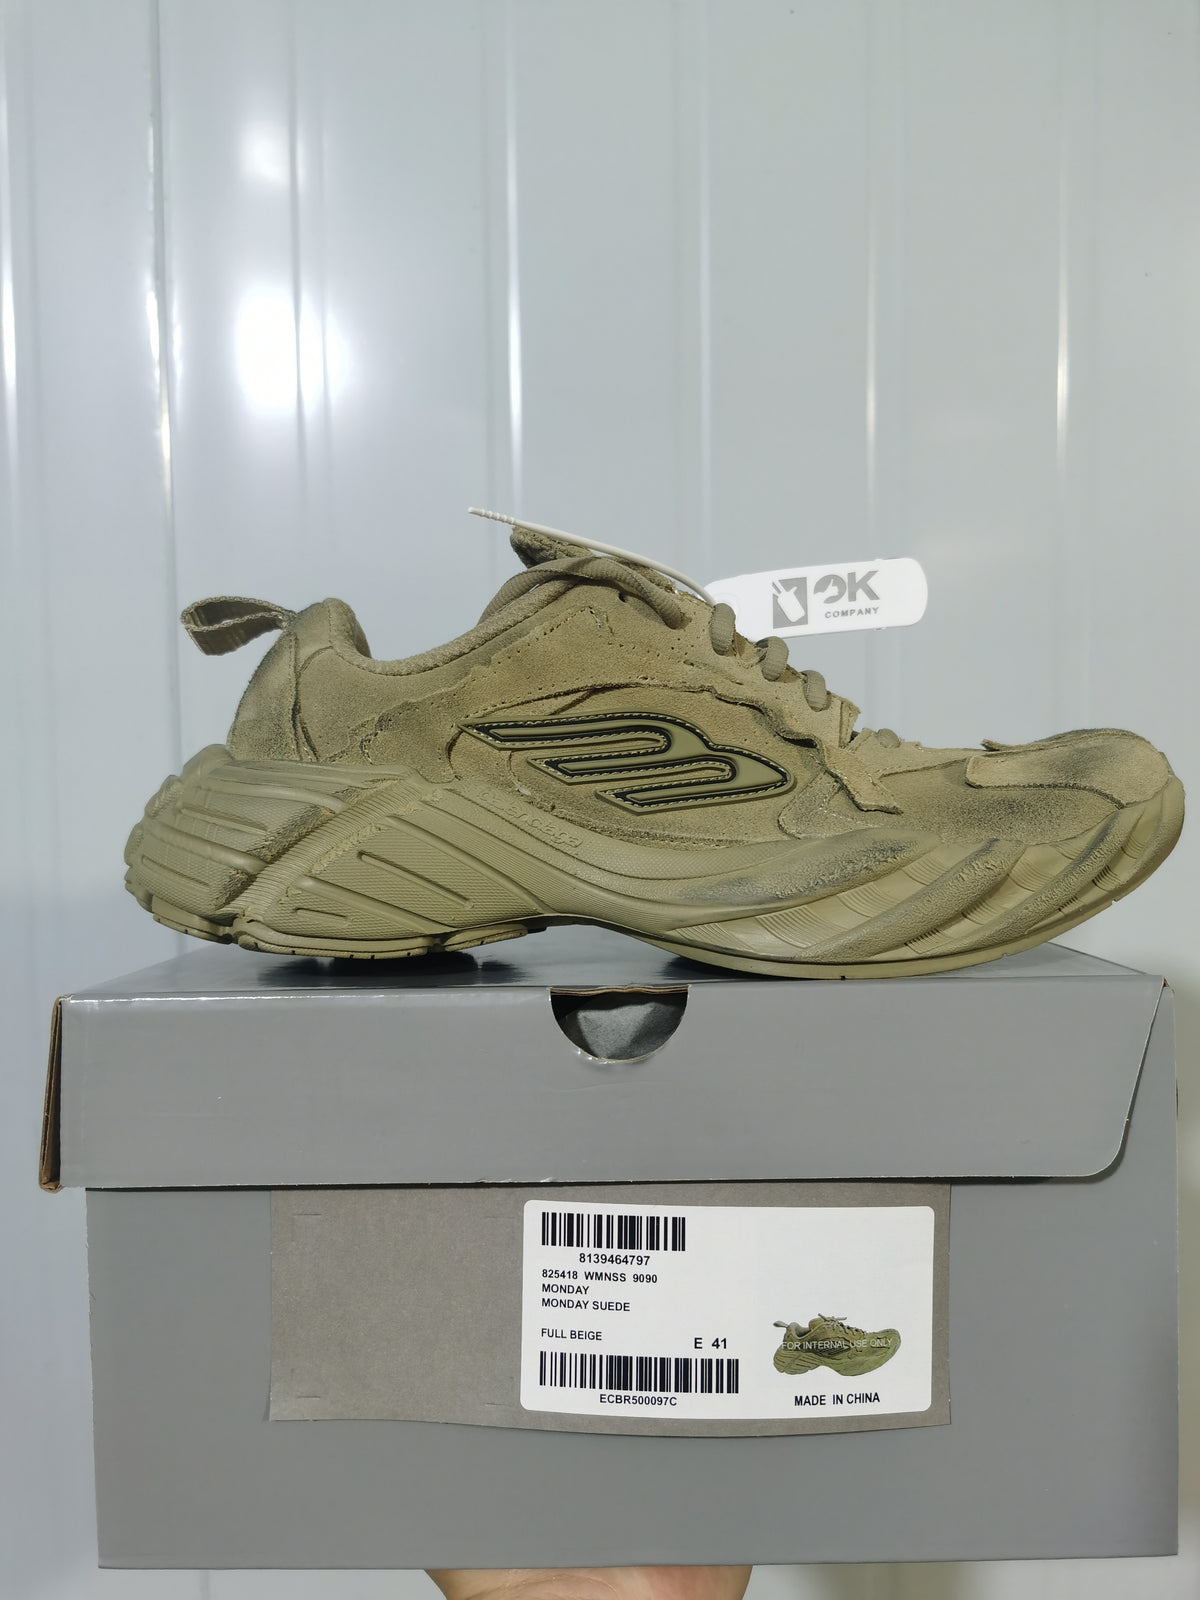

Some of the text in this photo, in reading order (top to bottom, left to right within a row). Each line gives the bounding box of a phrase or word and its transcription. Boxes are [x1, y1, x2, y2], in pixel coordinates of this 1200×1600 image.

[824, 606, 880, 619] COMPANY
[579, 1252, 651, 1266] 8139464797
[541, 1268, 658, 1284] 825418 WMNSS 9090
[541, 1283, 590, 1295] MONDAY
[541, 1298, 631, 1312] MONDAY SUEDE
[541, 1327, 603, 1341] FULL BEIGE
[693, 1337, 728, 1350] E 41
[782, 1341, 801, 1350] FOR
[803, 1340, 847, 1350] INTERNAL
[870, 1338, 893, 1347] ONLY
[599, 1393, 678, 1407] ECBR500097C
[794, 1391, 881, 1407] MADE IN CHINA
